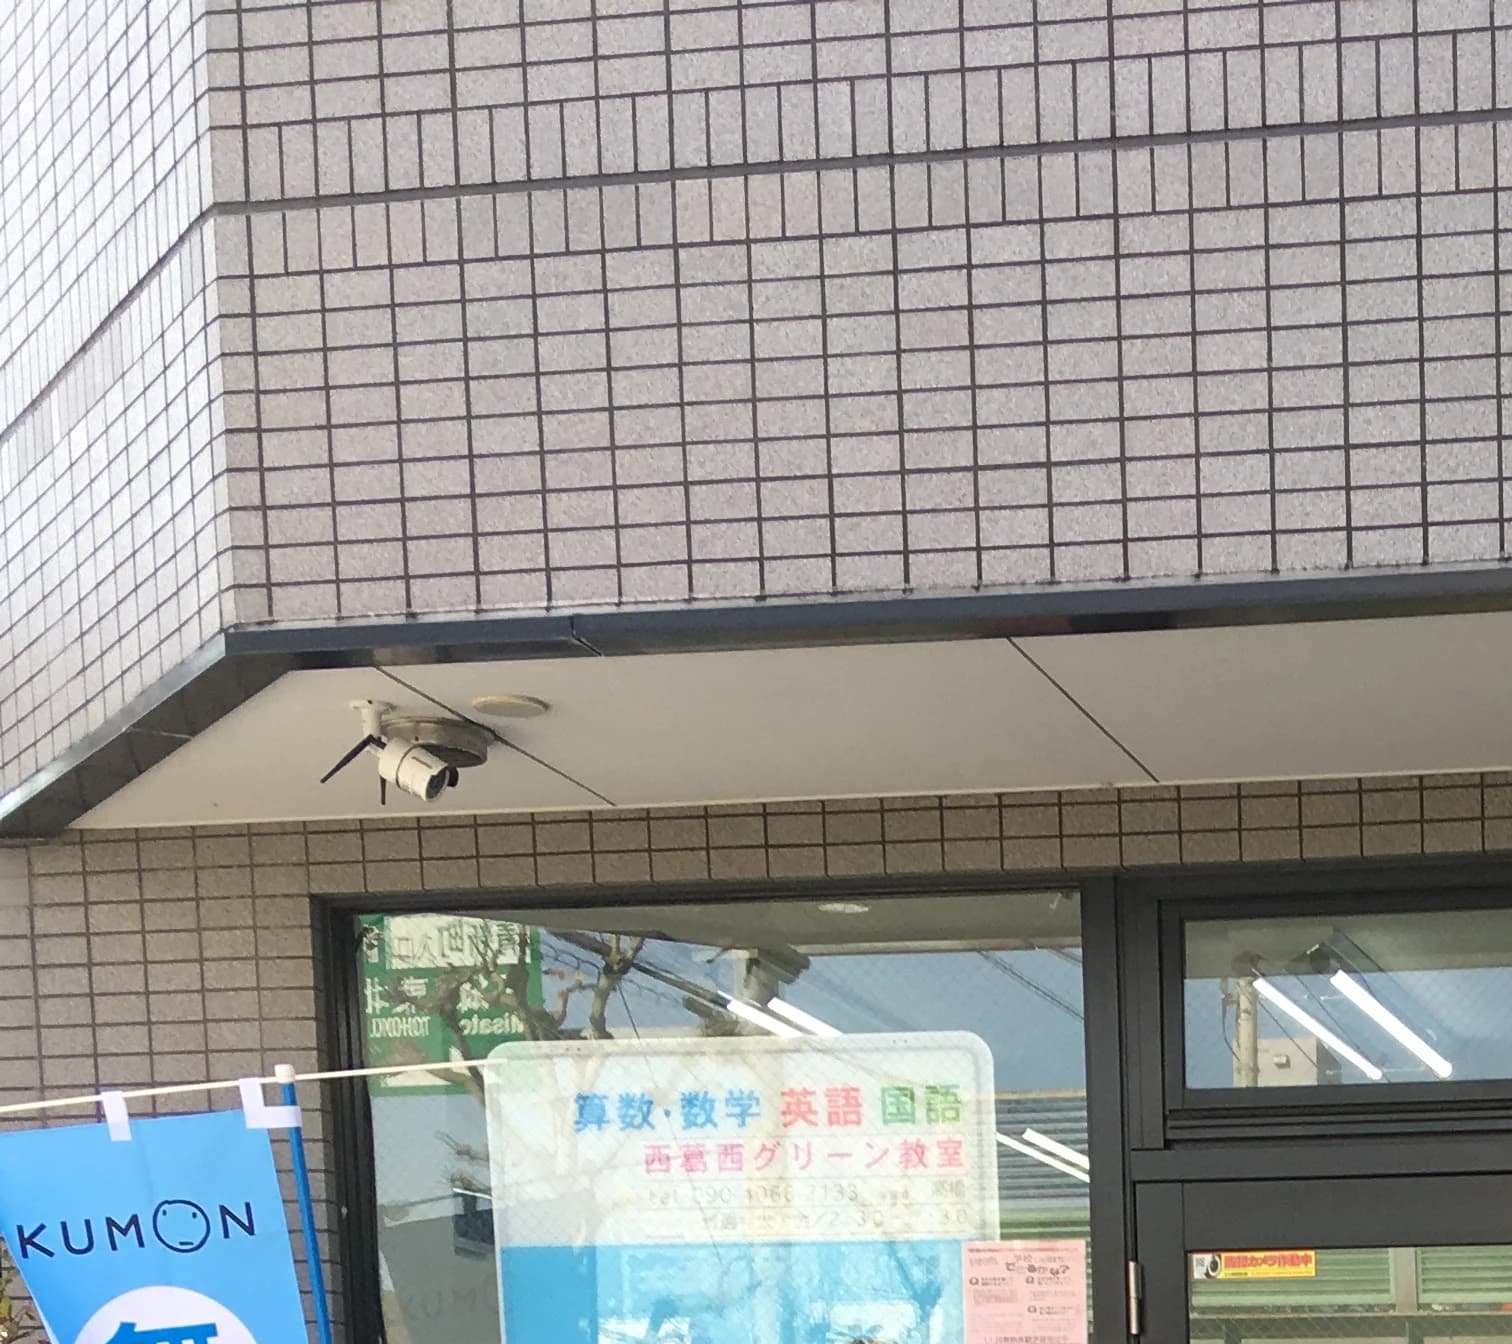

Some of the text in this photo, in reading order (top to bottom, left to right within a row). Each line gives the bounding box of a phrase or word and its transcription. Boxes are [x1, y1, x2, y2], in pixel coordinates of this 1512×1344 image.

[780, 1086, 864, 1128] 英語
[880, 1083, 963, 1127] 国語
[643, 1138, 965, 1175] 西葛西グリーン教室
[16, 1199, 256, 1259] KUMON
